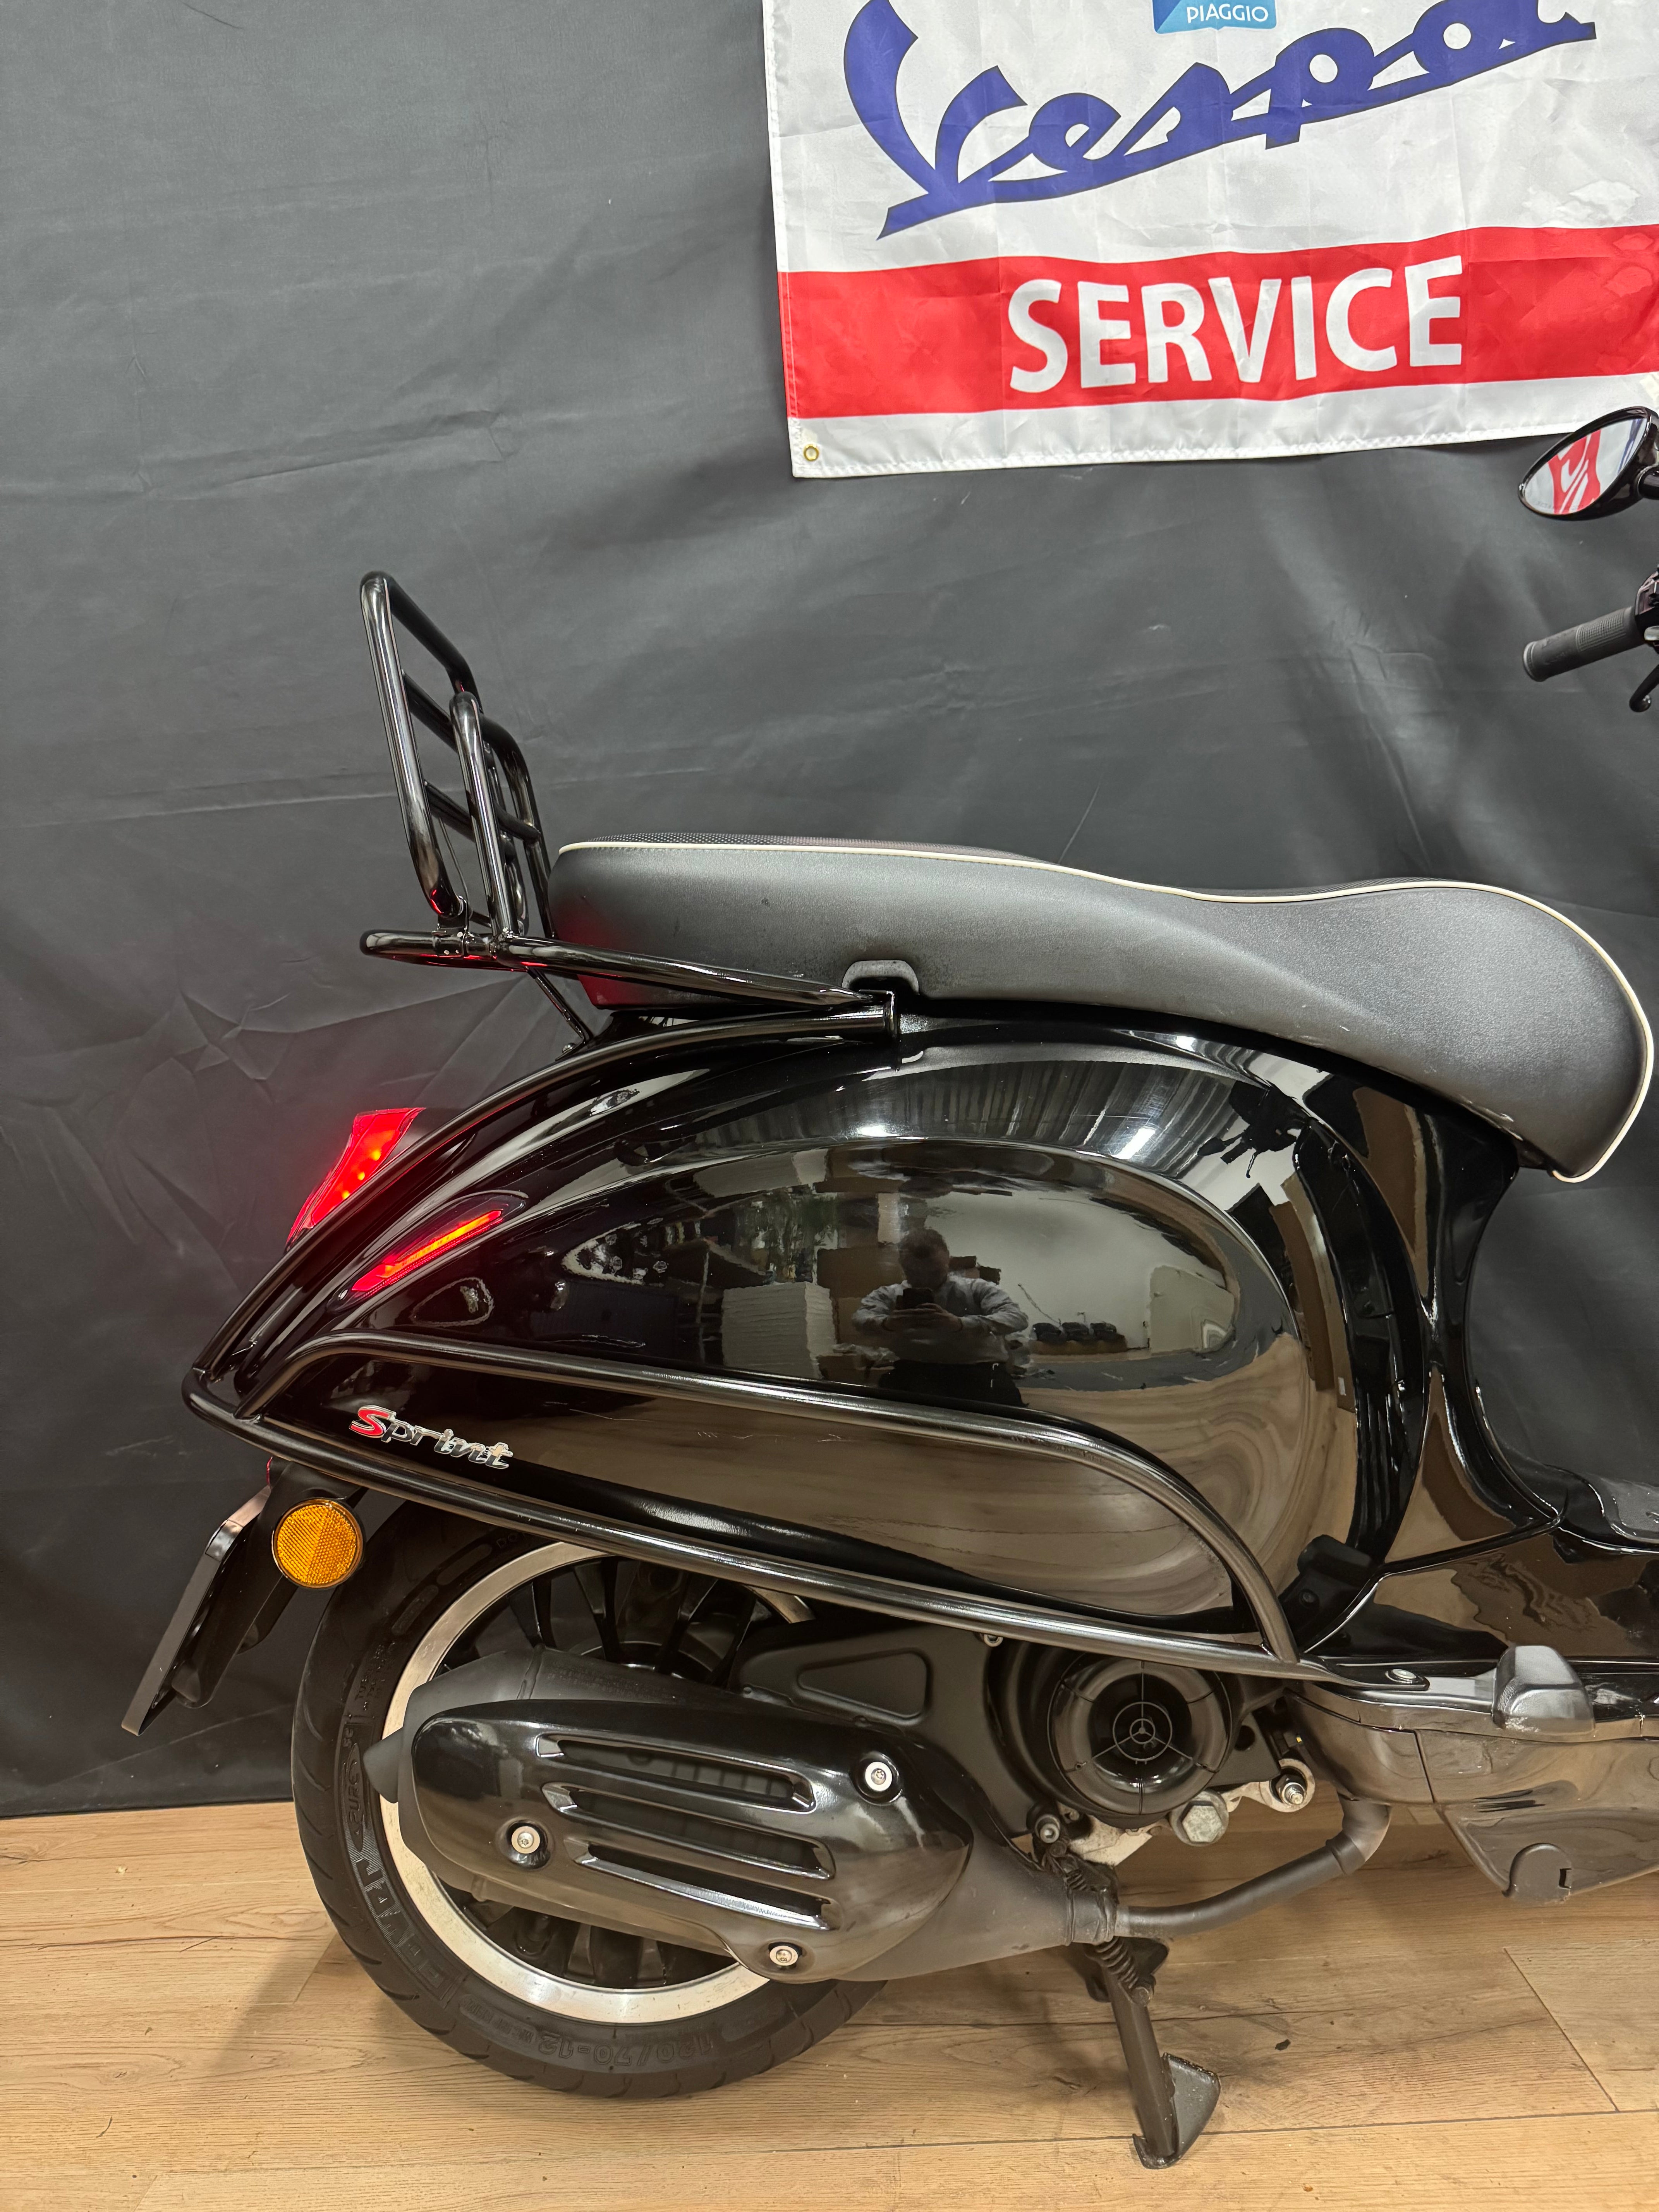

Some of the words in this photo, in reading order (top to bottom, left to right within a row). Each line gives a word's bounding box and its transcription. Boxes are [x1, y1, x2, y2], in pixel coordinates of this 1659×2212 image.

[1187, 3, 1269, 23] PIAGGIO
[843, 0, 1597, 241] Vespa
[1007, 256, 1463, 393] SERVICE
[349, 1405, 514, 1469] Sprint
[538, 2031, 715, 2066] 120/70-12
